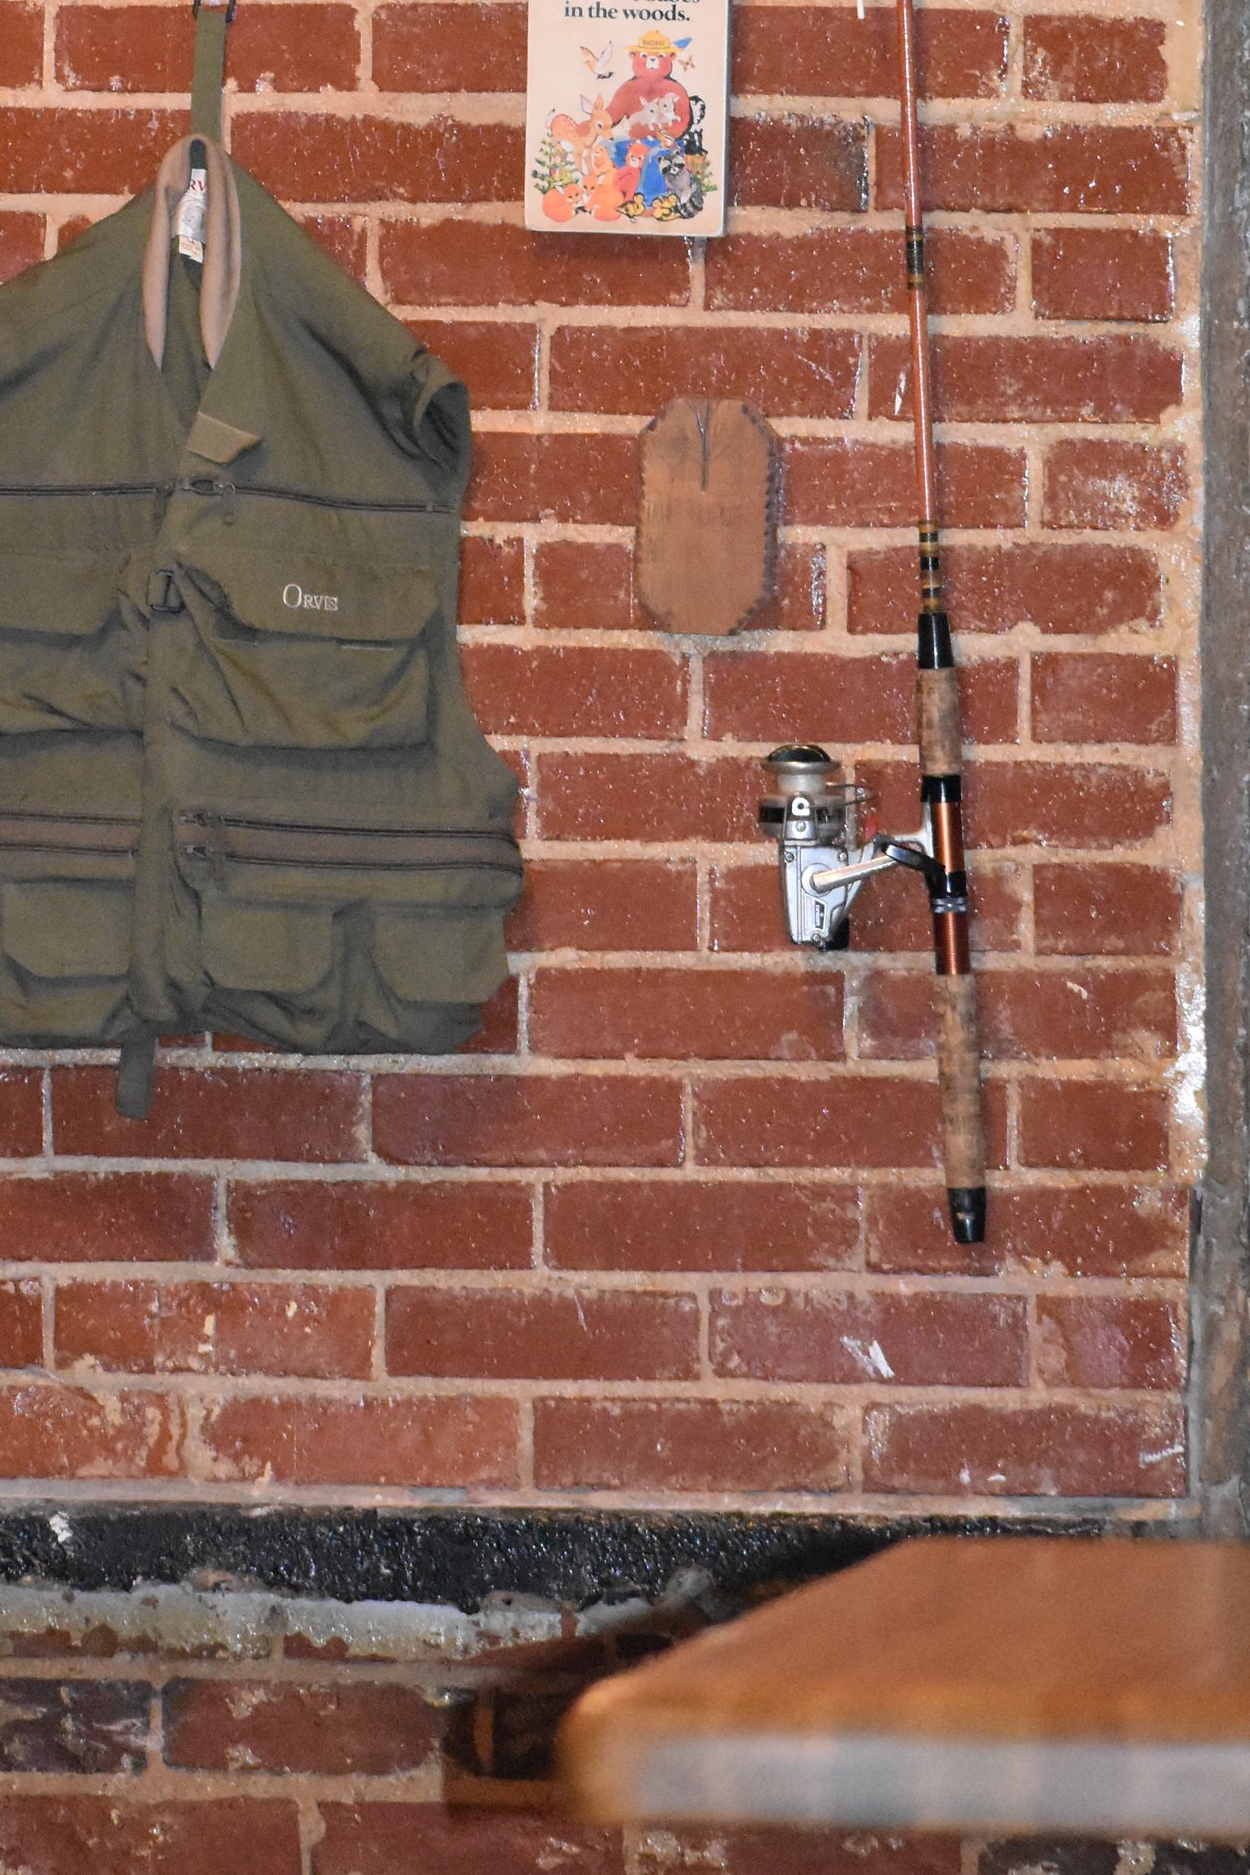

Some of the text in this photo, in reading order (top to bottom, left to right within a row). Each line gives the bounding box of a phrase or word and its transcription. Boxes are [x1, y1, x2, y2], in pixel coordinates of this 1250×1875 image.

[564, 0, 691, 21] in the woods.
